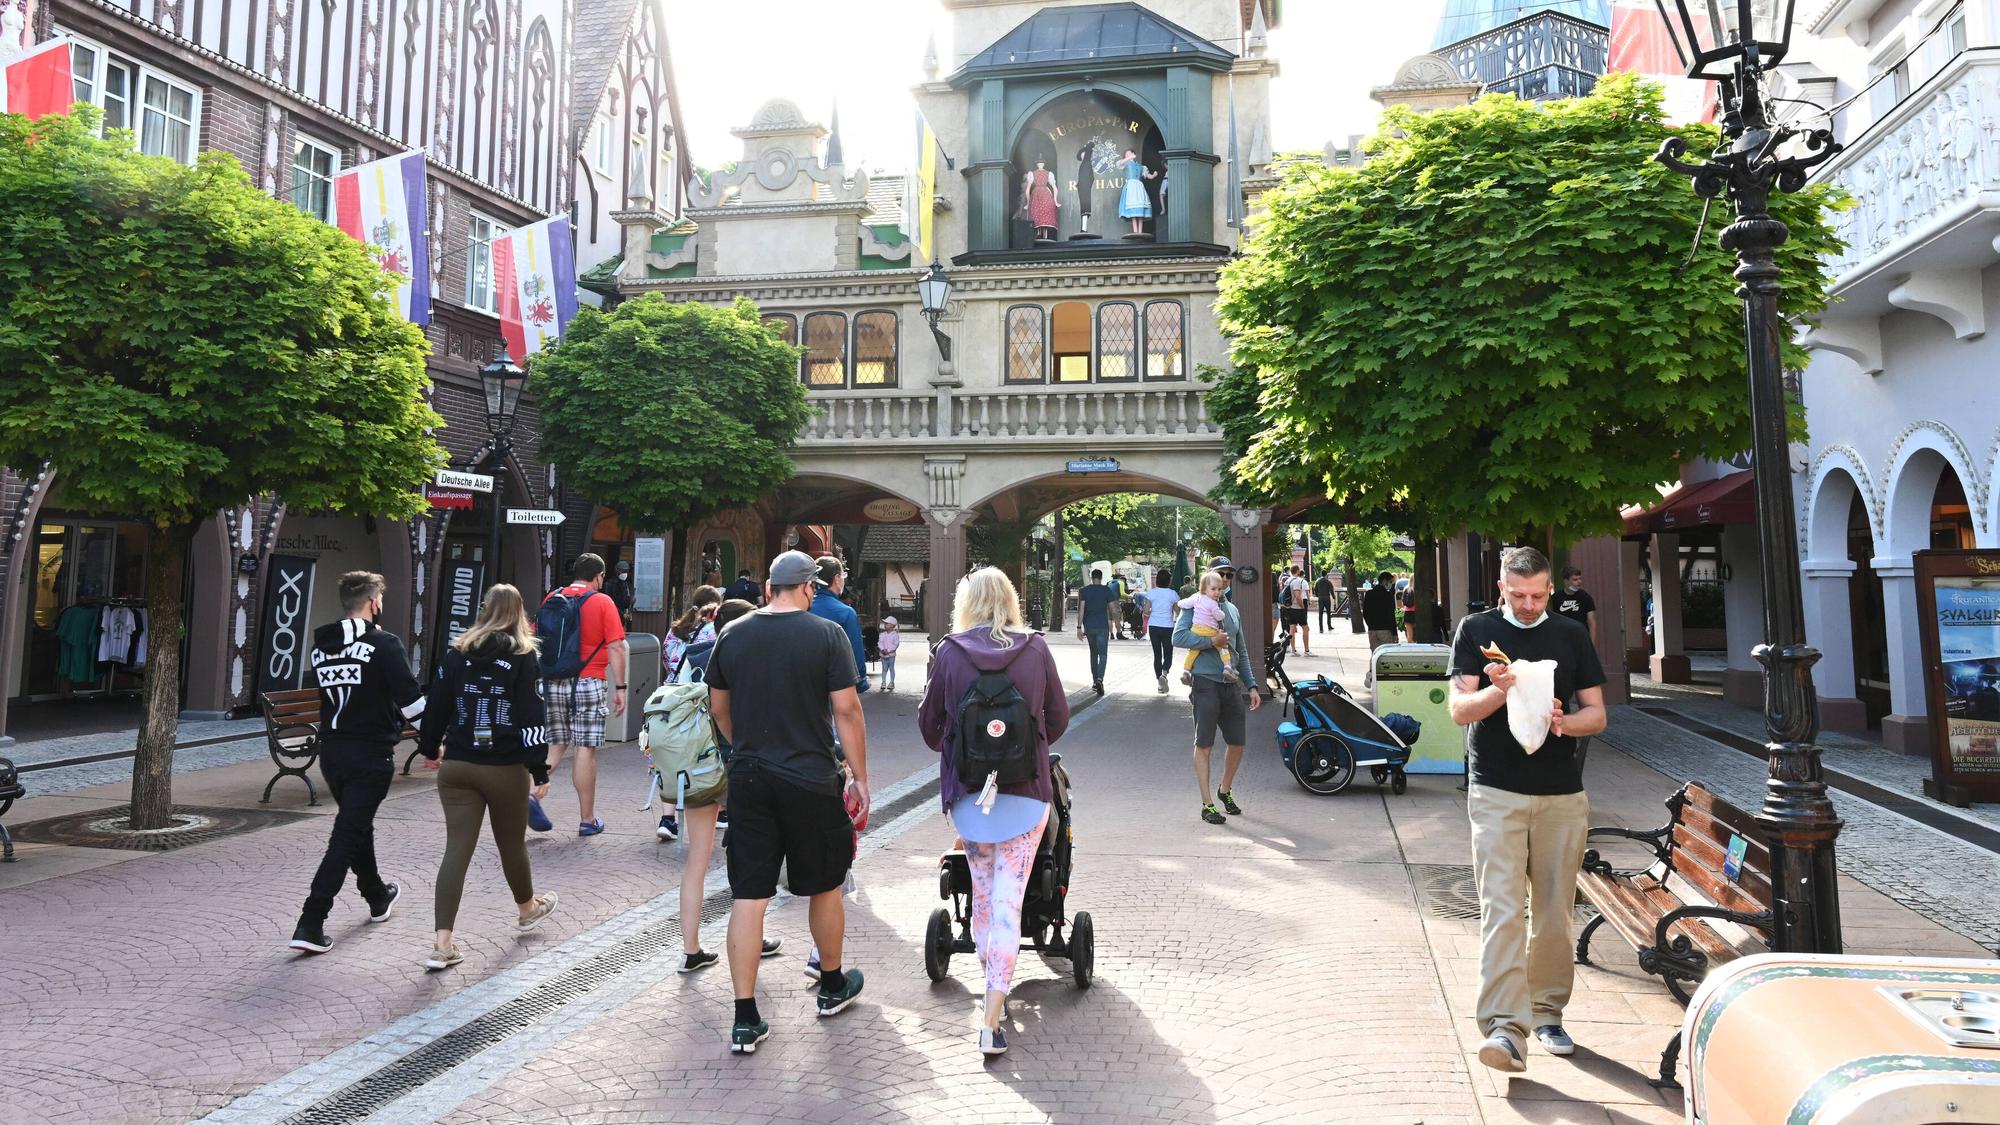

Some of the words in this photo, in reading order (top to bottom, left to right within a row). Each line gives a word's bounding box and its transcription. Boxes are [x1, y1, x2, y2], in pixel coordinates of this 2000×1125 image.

[1068, 178, 1128, 192] RHAU
[441, 473, 472, 487] Deutsche
[474, 477, 490, 489] Allee
[428, 490, 473, 500] Einkaufspassage
[511, 511, 556, 522] Toiletten
[451, 567, 474, 616] DAVID
